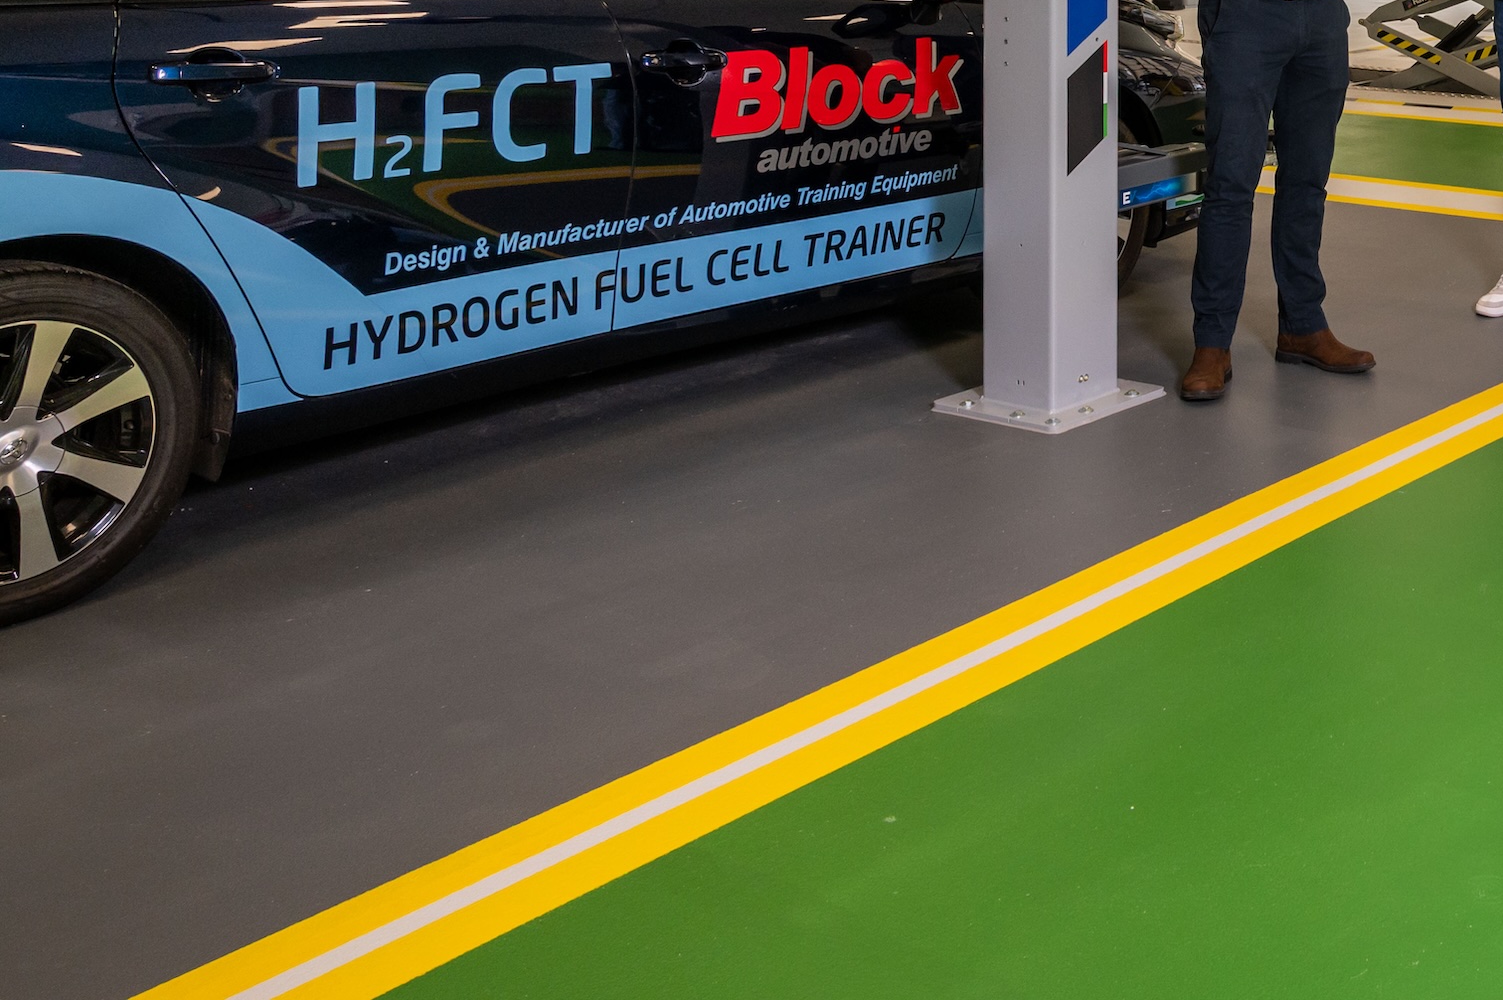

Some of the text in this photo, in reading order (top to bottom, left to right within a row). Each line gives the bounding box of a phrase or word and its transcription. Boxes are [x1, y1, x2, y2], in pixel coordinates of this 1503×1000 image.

[711, 37, 964, 143] Block
[756, 126, 933, 173] automotive
[384, 164, 958, 276] Design & Manufacturer of Automotive Training Equipment
[323, 212, 946, 370] HYDROGEN FUEL CELL TRAINER
